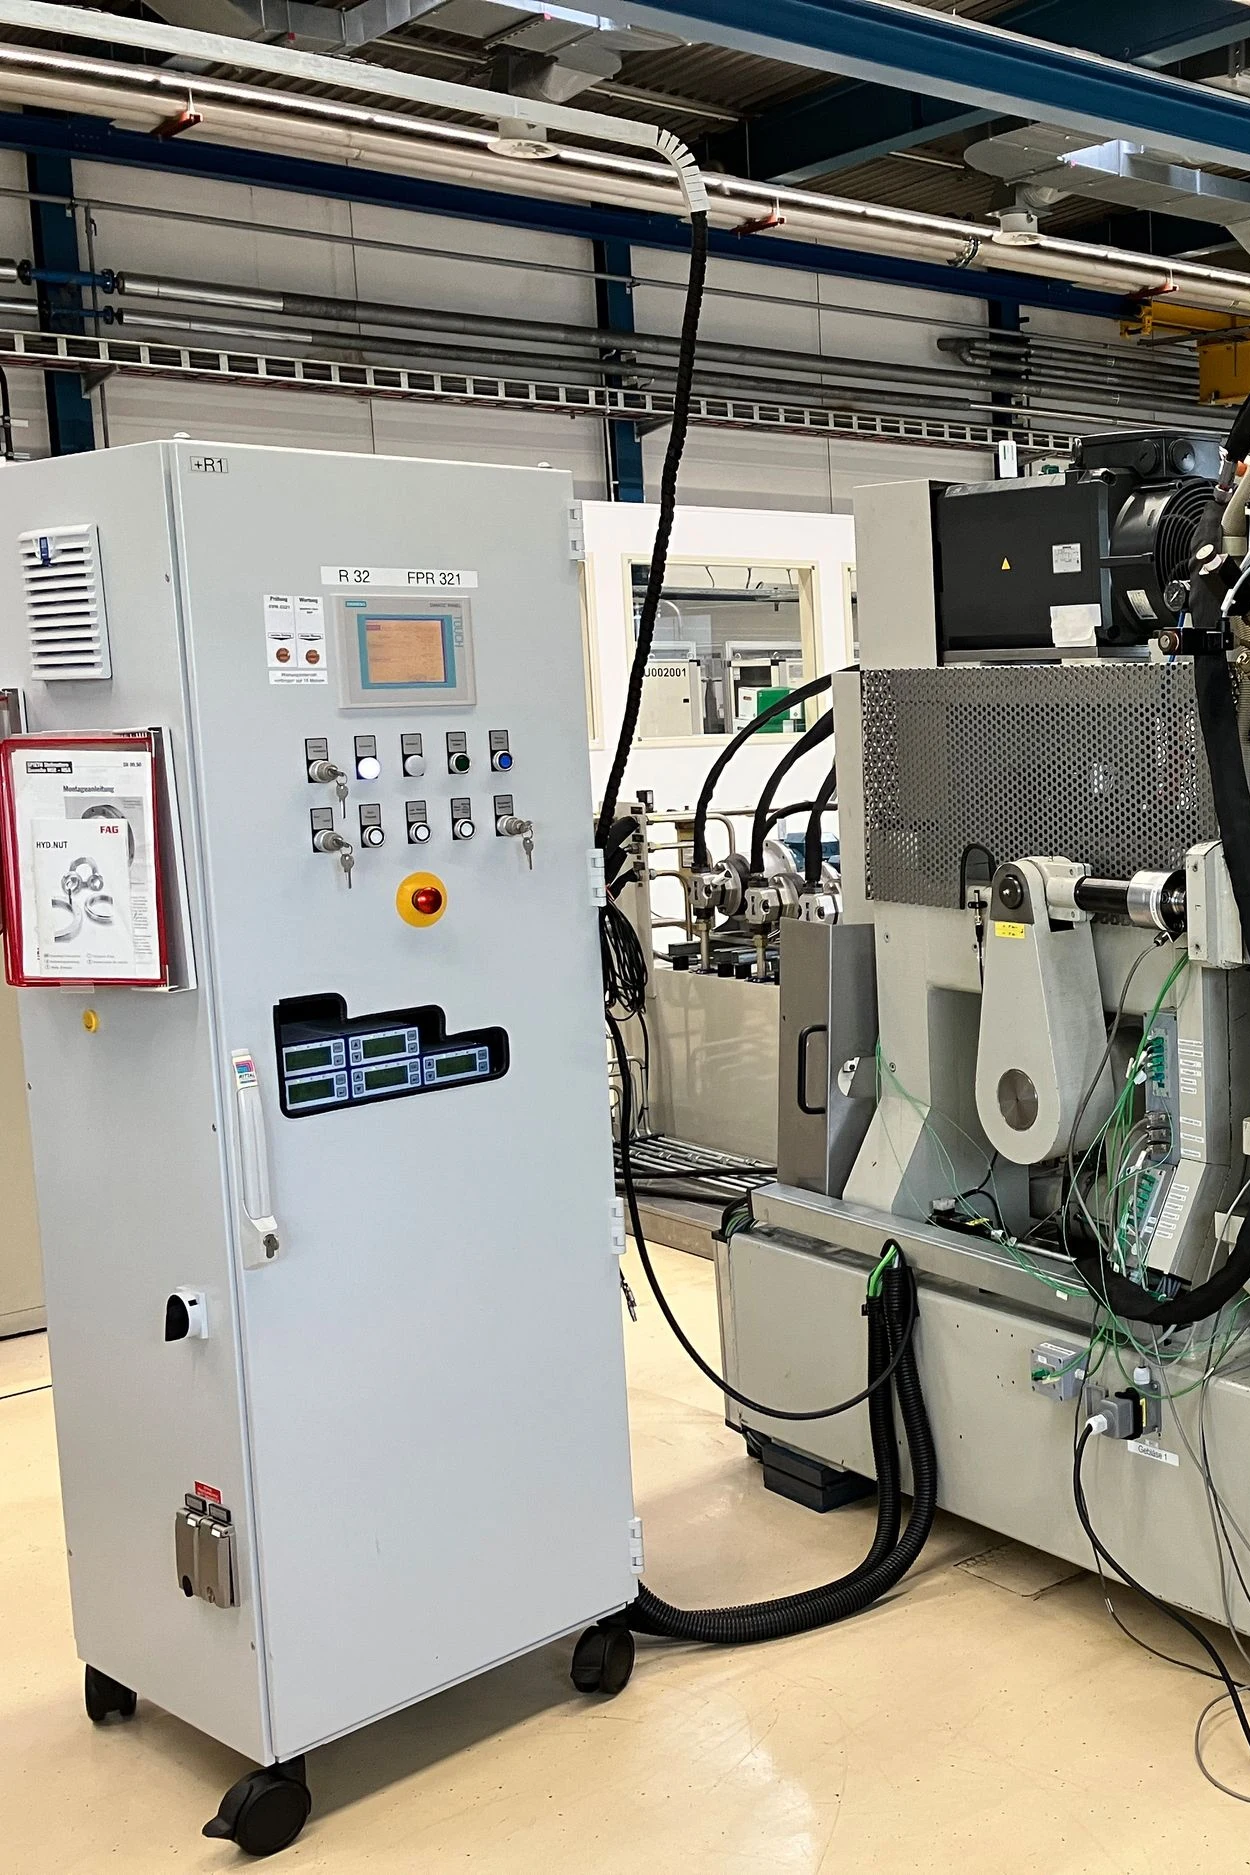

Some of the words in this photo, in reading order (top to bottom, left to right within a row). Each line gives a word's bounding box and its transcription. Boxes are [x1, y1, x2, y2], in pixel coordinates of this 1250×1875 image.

[194, 457, 223, 472] +R1
[338, 569, 349, 582] R
[353, 569, 370, 583] 32
[407, 571, 436, 585] FPR
[439, 572, 462, 586] 321
[453, 615, 464, 648] TOUCH
[63, 785, 115, 794] Montageanleitung
[100, 825, 119, 834] FAG
[36, 840, 68, 849] HYD.NUT
